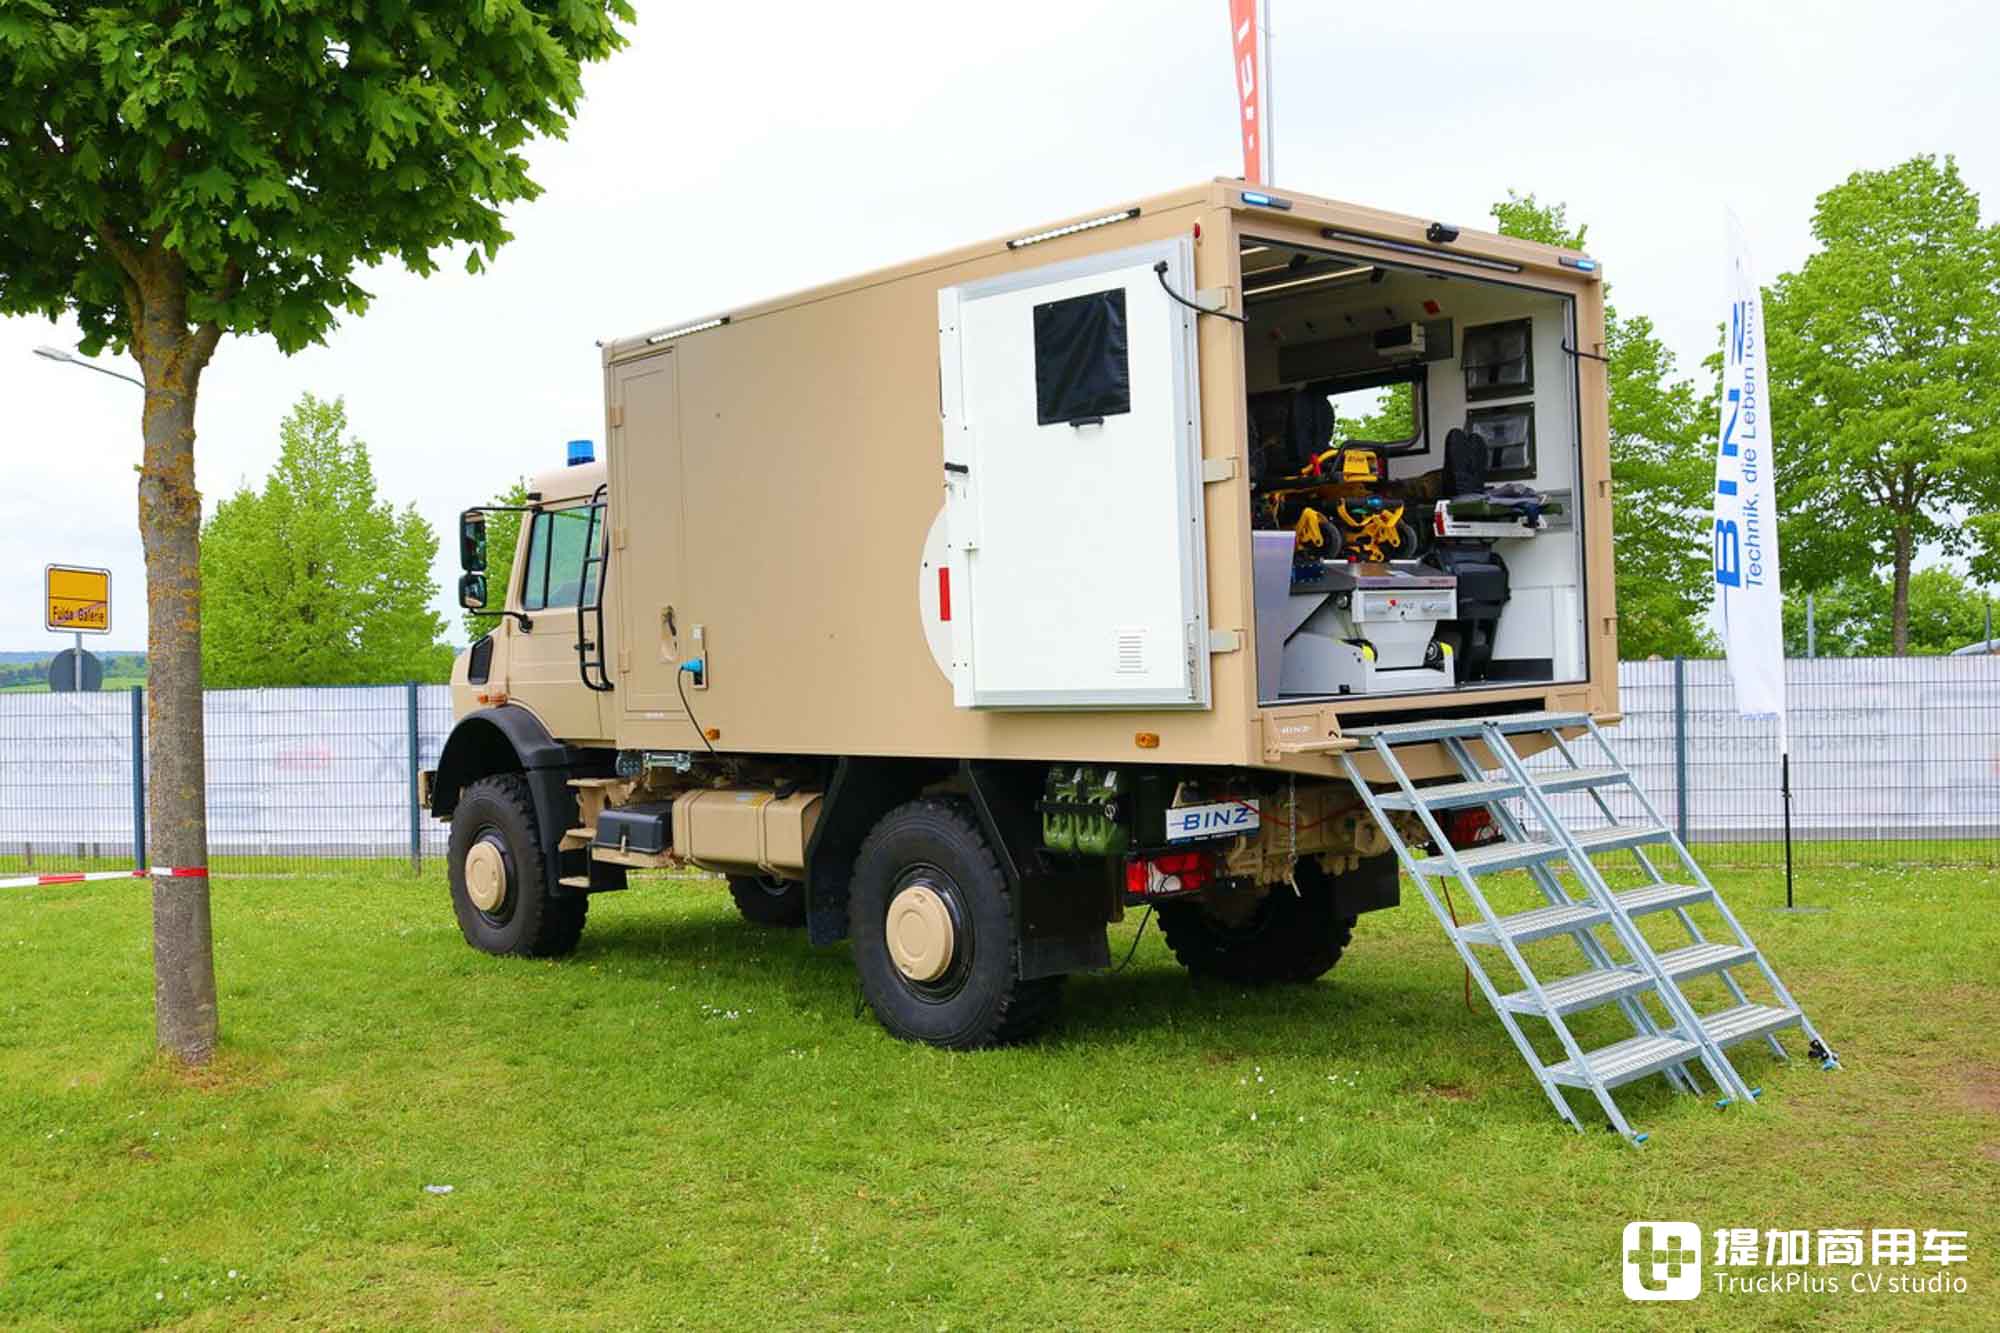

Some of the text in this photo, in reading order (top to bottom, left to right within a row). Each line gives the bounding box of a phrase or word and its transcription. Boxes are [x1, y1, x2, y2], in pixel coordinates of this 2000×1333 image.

[1741, 366, 1757, 440] Leben
[1716, 300, 1745, 587] BINZ
[1741, 447, 1758, 483] die
[1742, 493, 1763, 590] Technik,
[1183, 807, 1249, 830] BINZ
